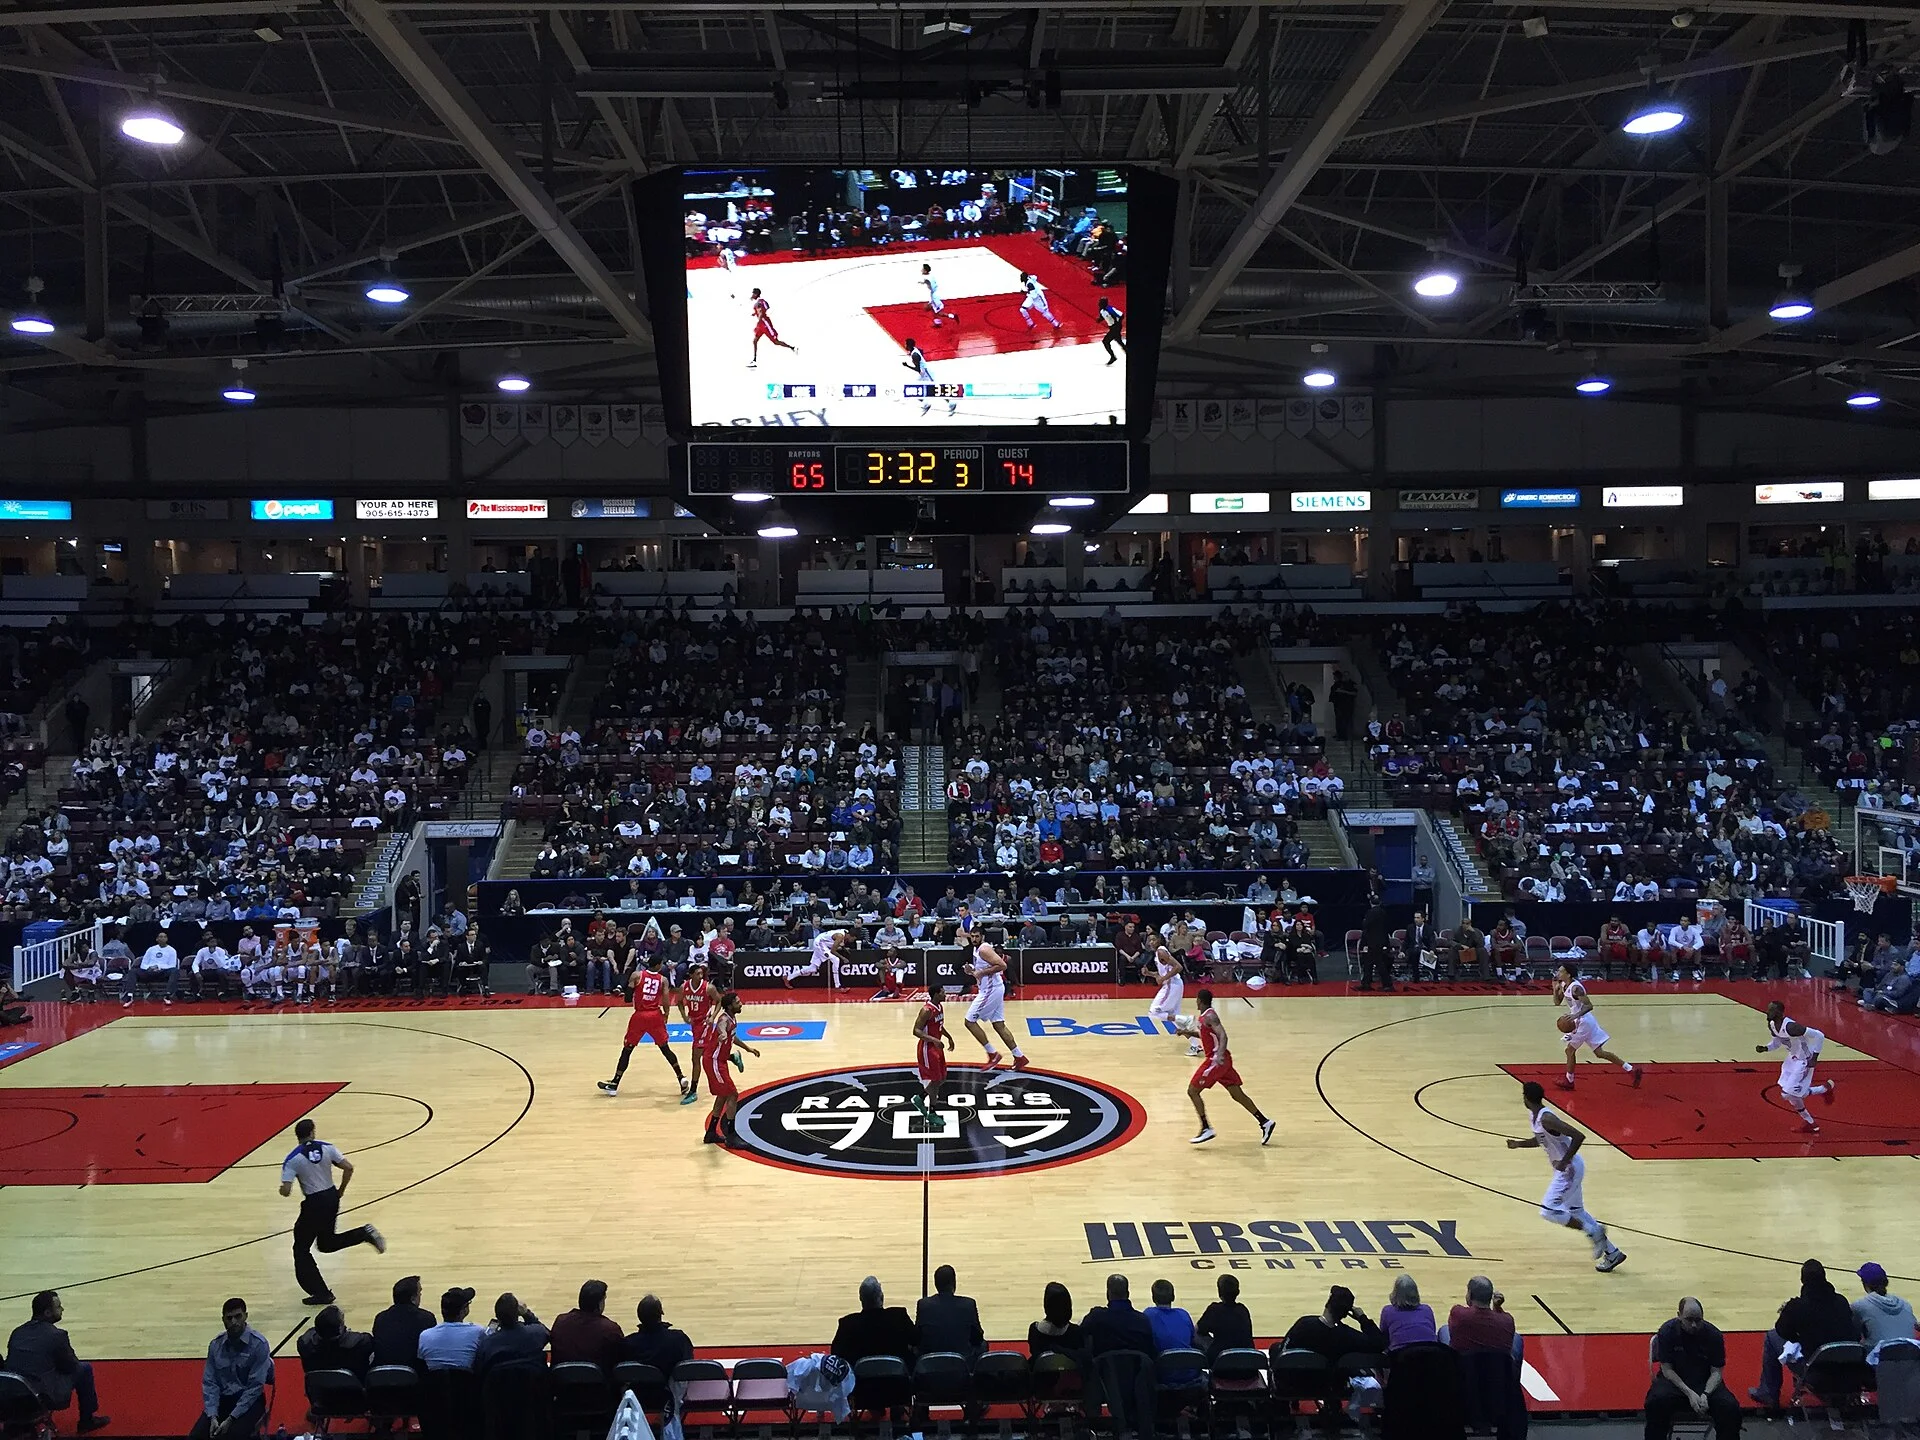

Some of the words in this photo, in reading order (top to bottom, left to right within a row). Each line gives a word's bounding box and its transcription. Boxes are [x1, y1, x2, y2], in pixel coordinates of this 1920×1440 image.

[788, 450, 821, 458] RAPTORS
[943, 448, 979, 460] PERIOD
[997, 448, 1030, 459] GUEST
[867, 452, 936, 484] 3:32
[1003, 463, 1034, 485] 74
[792, 464, 825, 488] 65
[956, 463, 969, 487] 3
[1296, 496, 1365, 508] SIEMENS
[1406, 492, 1470, 501] LAMAR
[283, 502, 321, 517] pepsi
[360, 501, 388, 509] YOUR
[390, 501, 405, 509] AD
[408, 501, 434, 509] HERE
[480, 504, 491, 512] The
[491, 504, 529, 513] Mississauga
[529, 504, 546, 512] News
[743, 965, 820, 977] GATORA
[1032, 961, 1109, 974] GATORADE
[642, 977, 659, 995] 23
[690, 1001, 699, 1011] 13
[1025, 1015, 1179, 1037] Bell
[801, 1092, 1053, 1109] RAPORS
[780, 1108, 1071, 1150] 905
[1083, 1220, 1473, 1260] HERSHEY
[1190, 1258, 1405, 1270] CENTRE
